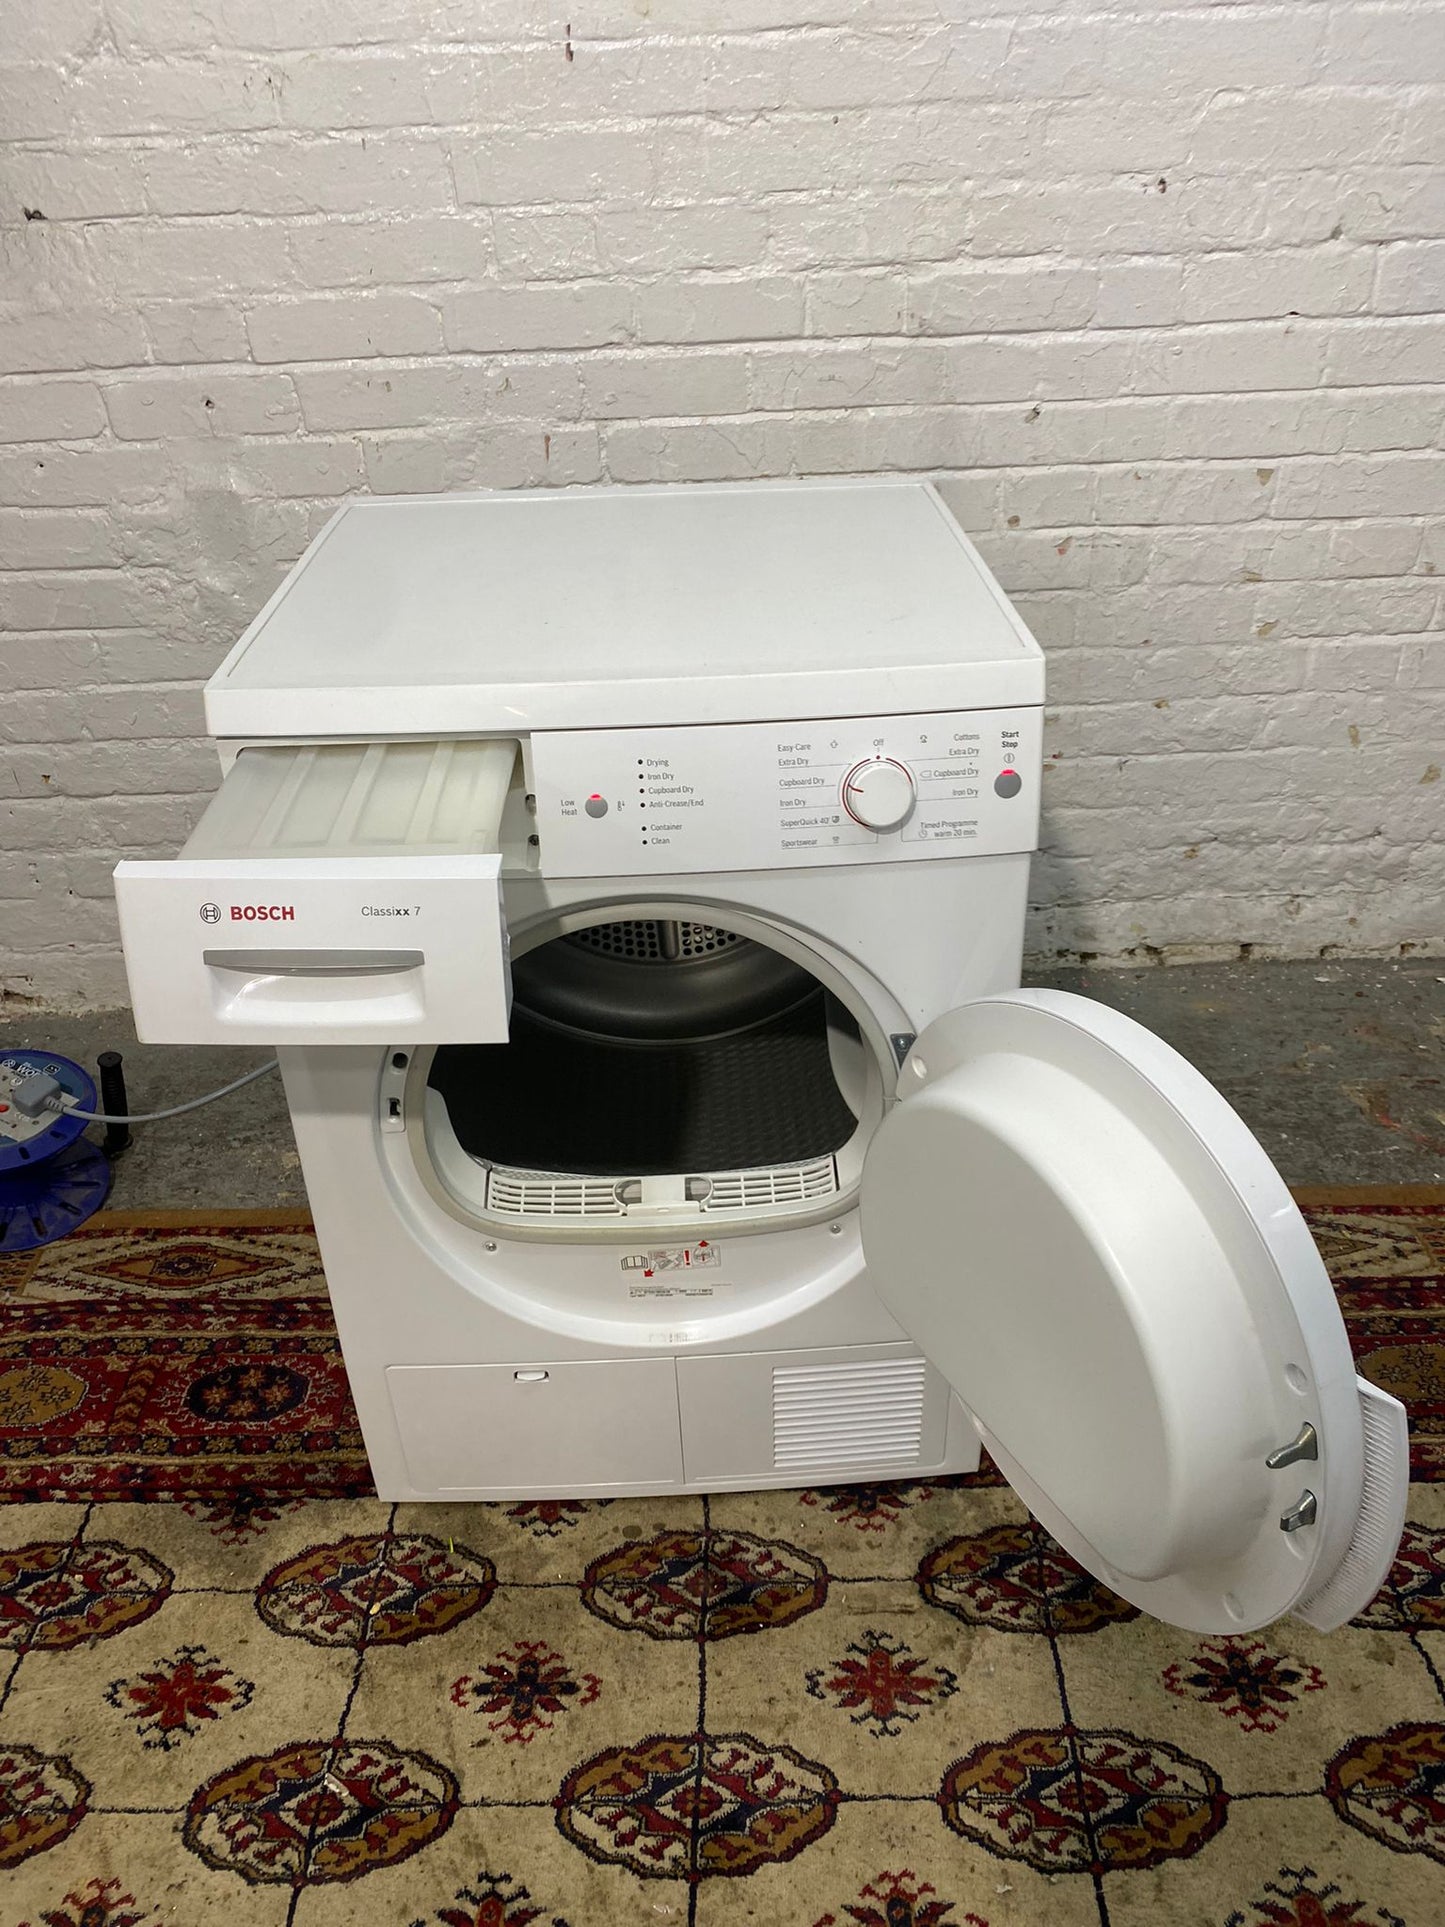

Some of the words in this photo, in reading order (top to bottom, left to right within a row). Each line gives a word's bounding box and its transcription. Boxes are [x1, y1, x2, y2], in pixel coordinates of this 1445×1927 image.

[873, 738, 884, 746] Off
[968, 747, 979, 756] Dry
[646, 758, 669, 767] Drying
[796, 758, 808, 766] Dry
[662, 772, 674, 781] Dry
[933, 769, 966, 778] Cupboard
[967, 768, 979, 776] Dry
[779, 778, 811, 787] Cupboard
[813, 777, 825, 786] Dry
[648, 786, 681, 795] Cupboard
[682, 786, 694, 794] Dry
[967, 788, 978, 796] Dry
[649, 799, 704, 808] Anti-Crease/End
[794, 798, 806, 806] Dry
[650, 823, 682, 831] Container
[780, 818, 818, 828] SuperQuick
[920, 821, 940, 829] Timed
[942, 820, 978, 828] Programme
[781, 838, 817, 848] Sportswear
[230, 906, 295, 920] BOSCH
[361, 906, 410, 917] Classixx
[414, 906, 421, 916] 7
